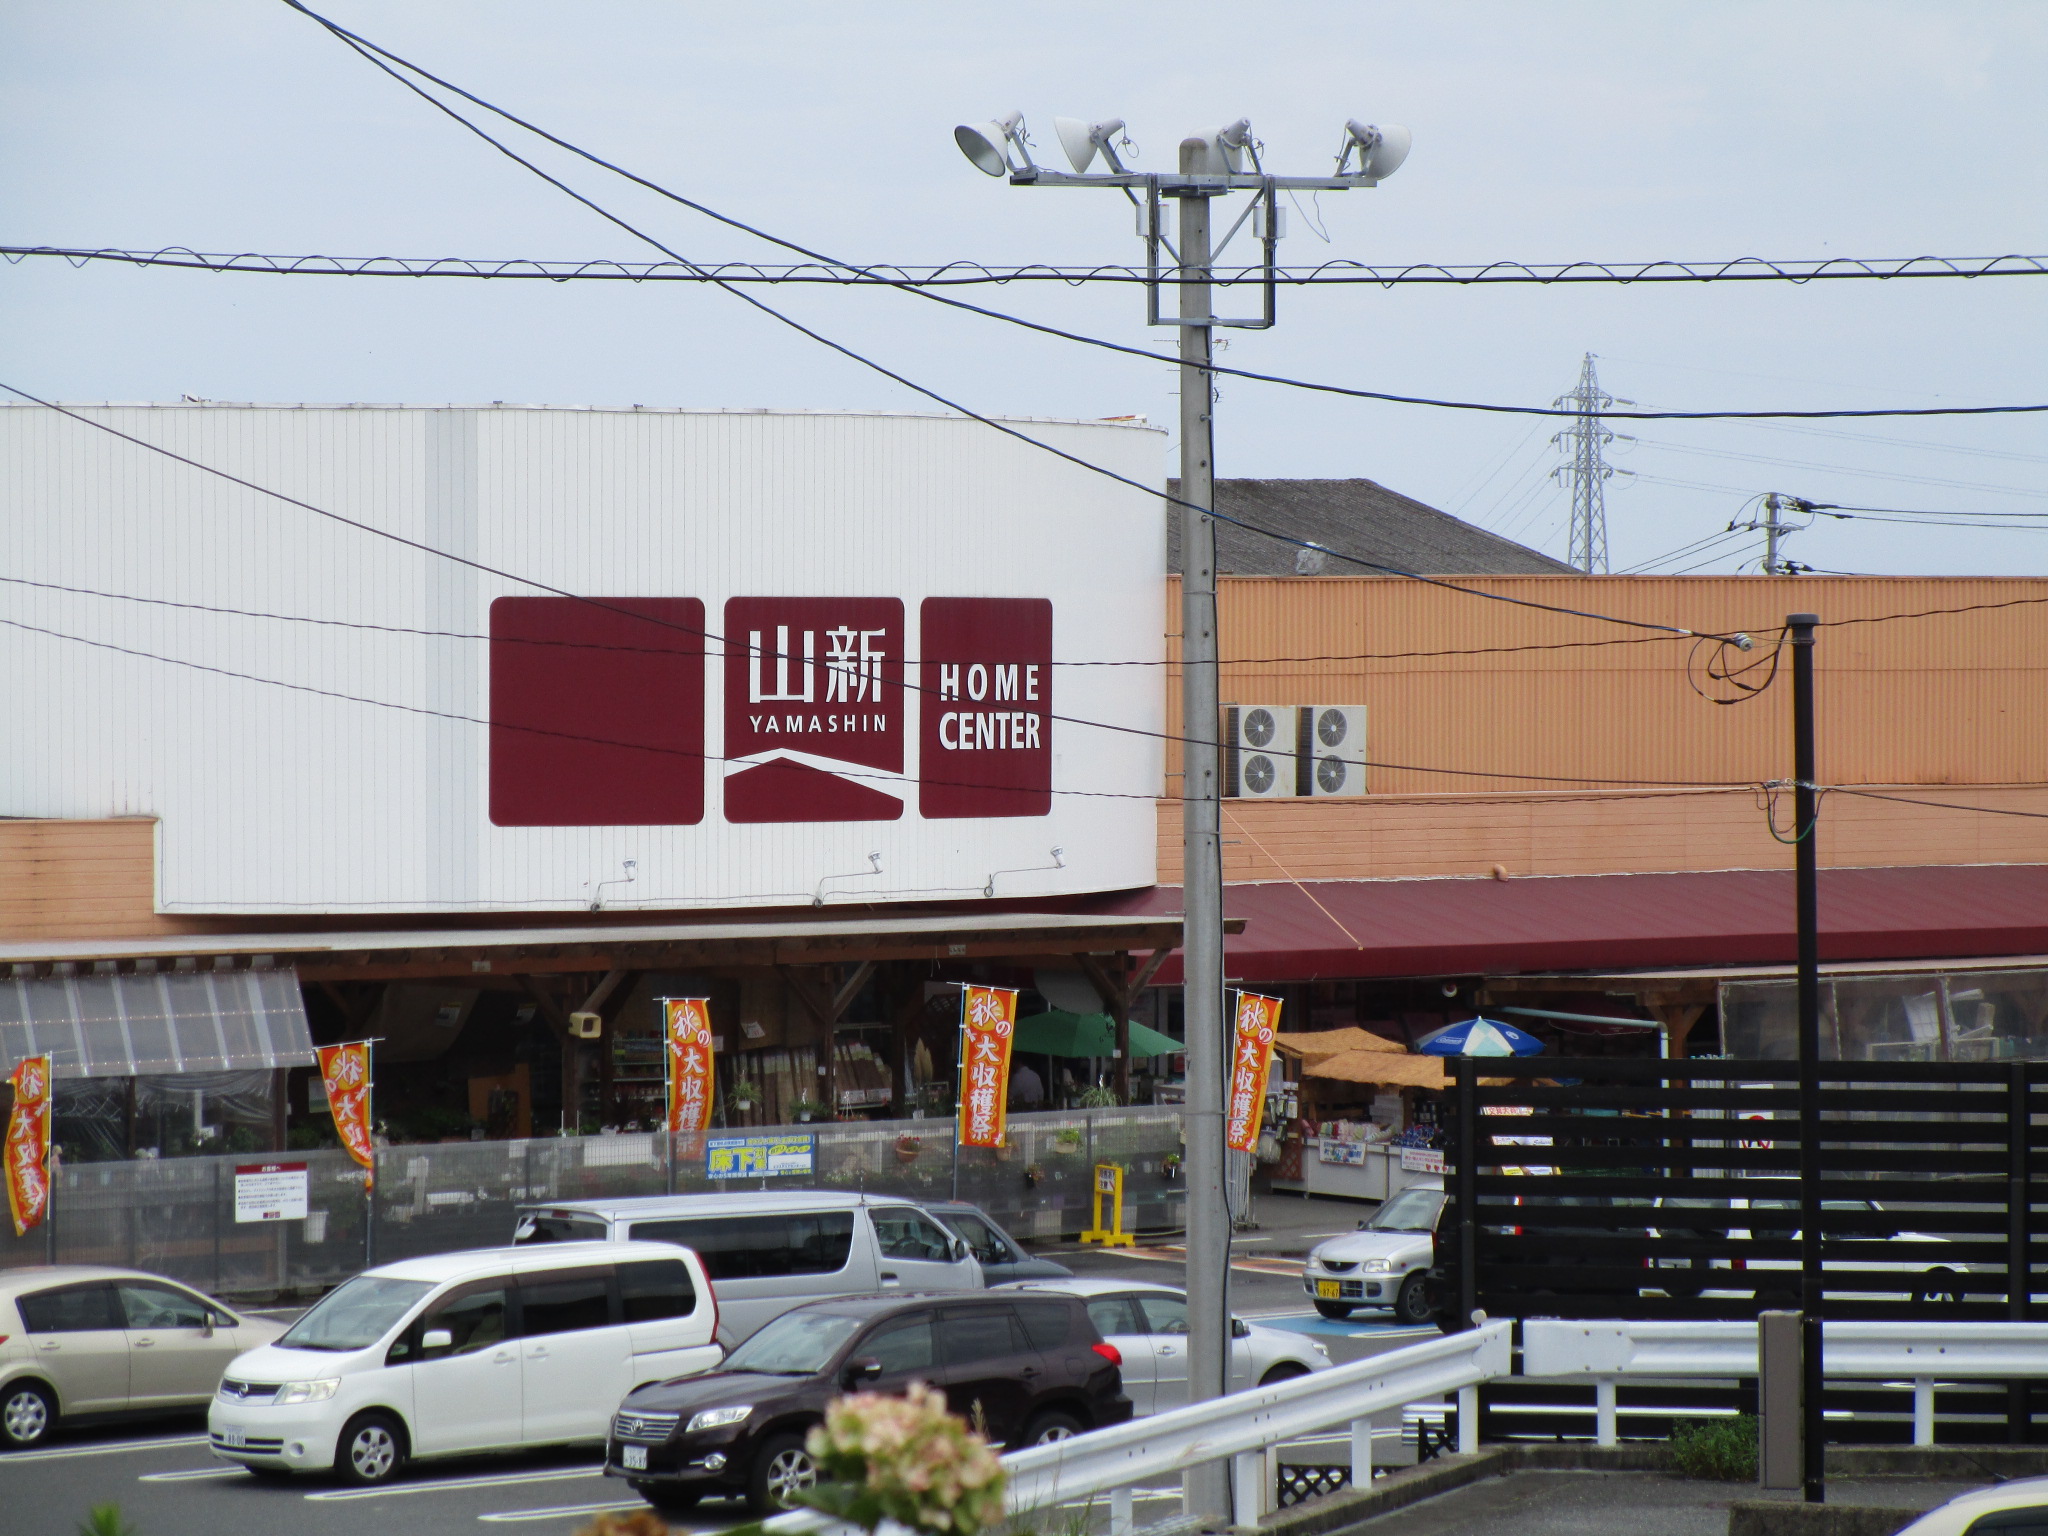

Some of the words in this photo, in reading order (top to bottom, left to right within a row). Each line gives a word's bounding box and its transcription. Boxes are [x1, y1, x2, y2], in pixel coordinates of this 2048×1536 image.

[749, 625, 886, 704] 山新
[940, 663, 1040, 702] HOME
[749, 714, 887, 734] YAMASHIN
[939, 711, 1041, 751] CENTER
[968, 993, 1012, 1141] 秋の大収穫祭
[1229, 1001, 1274, 1145] 秋の大収穫祭
